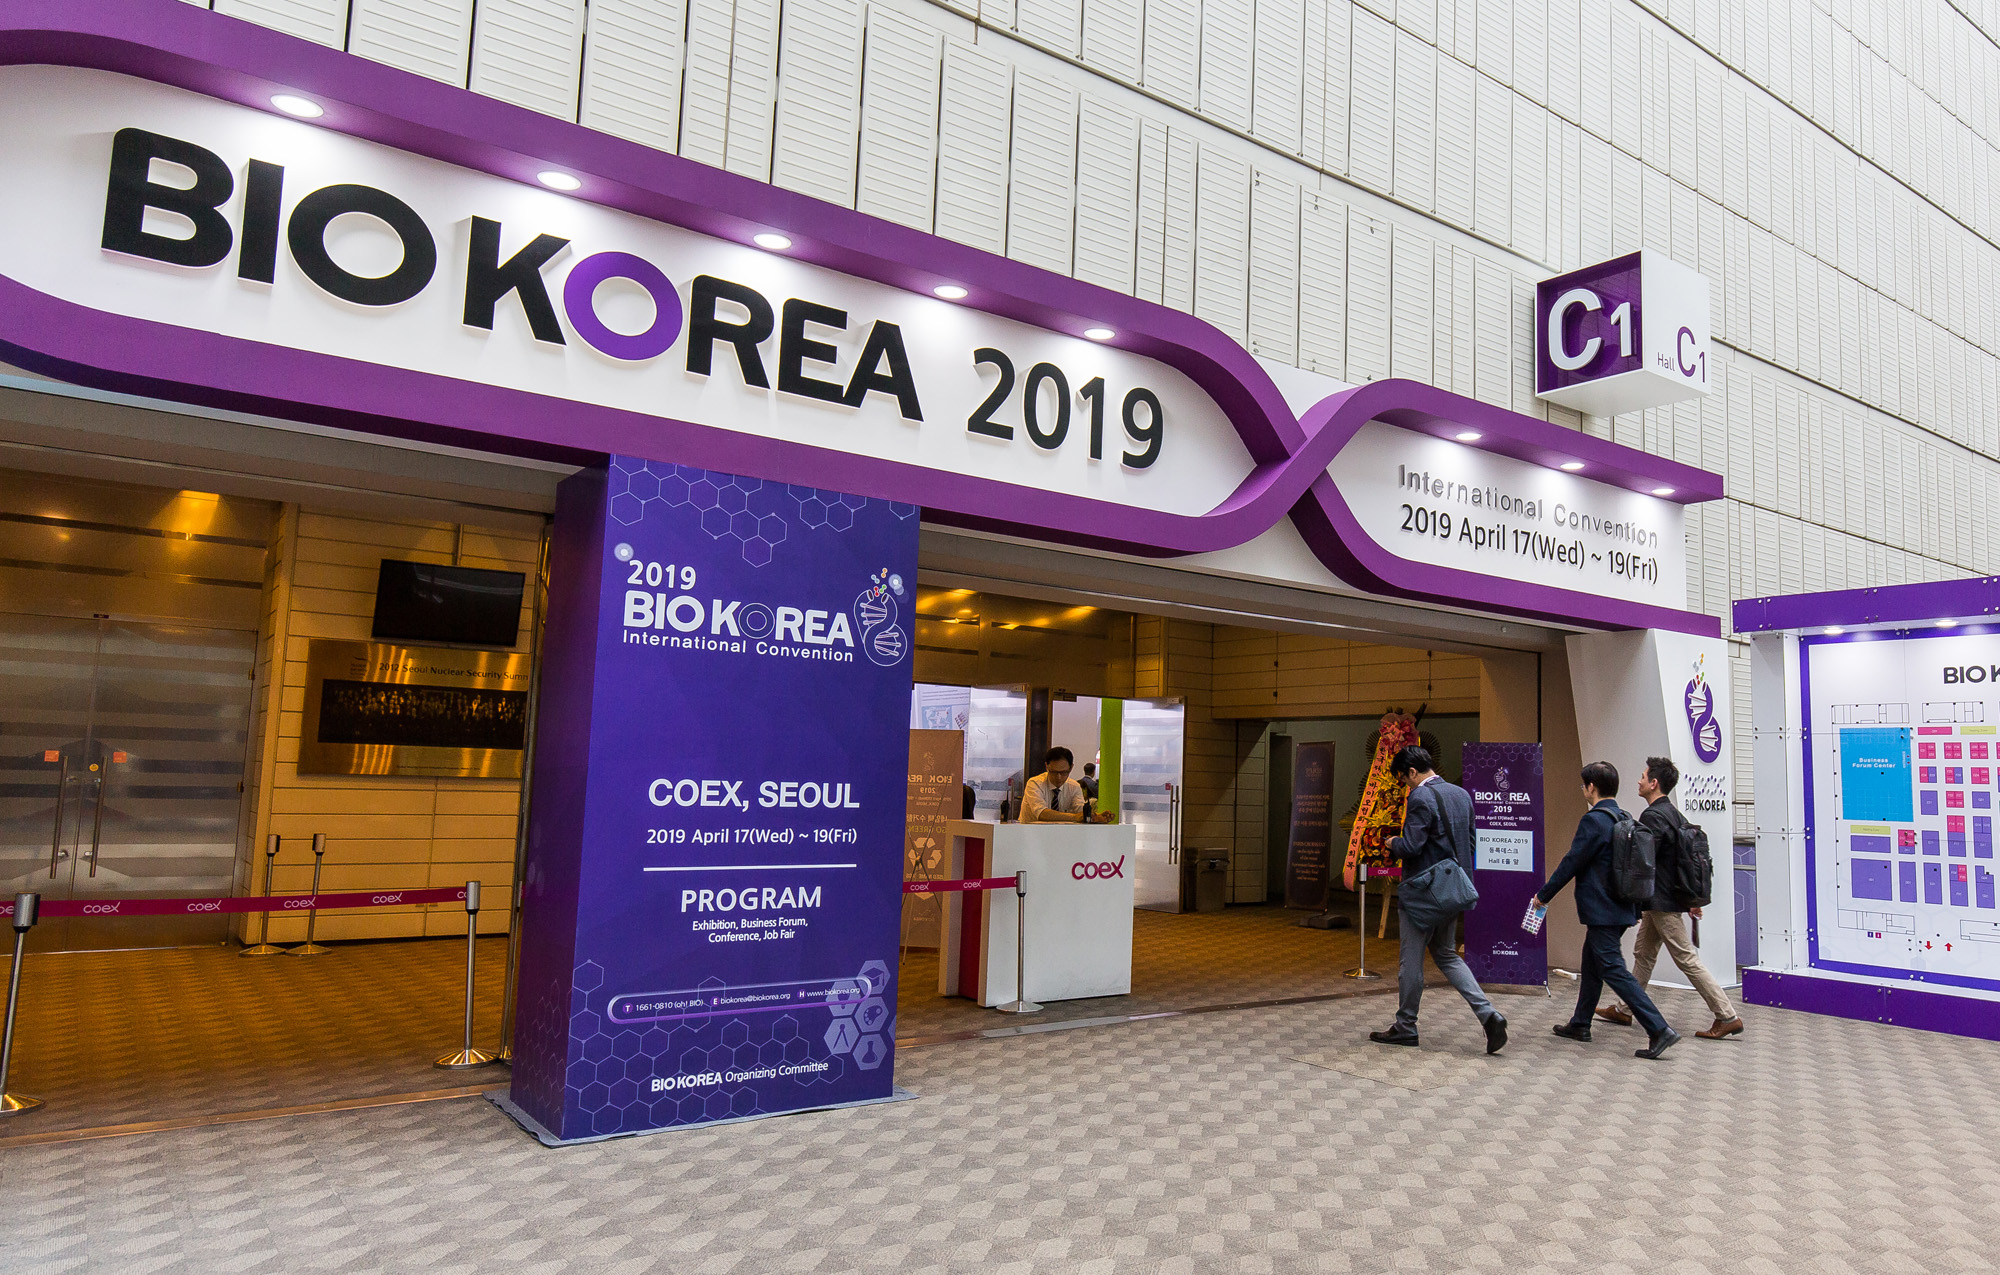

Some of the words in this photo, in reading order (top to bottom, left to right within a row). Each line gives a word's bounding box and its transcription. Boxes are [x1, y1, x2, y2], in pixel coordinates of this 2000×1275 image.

[101, 126, 438, 307] BIO
[462, 214, 925, 423] KOREA
[967, 346, 1165, 470] 2019
[1548, 288, 1632, 371] C1
[1657, 352, 1676, 372] Hall
[1677, 326, 1706, 384] C1
[1398, 464, 1543, 522] International
[1554, 503, 1658, 549] Convention
[1401, 503, 1451, 539] 2019
[1458, 517, 1506, 550] April
[1512, 528, 1585, 569] 17(Wed)
[1591, 552, 1602, 562] ~
[1608, 550, 1658, 584] 19(Fri)
[627, 559, 697, 590] 2019
[623, 589, 705, 633] BIO
[710, 599, 855, 647] KOREA
[623, 629, 747, 653] International
[756, 641, 854, 662] Convention
[379, 662, 399, 672] 2012
[402, 664, 428, 674] Seoul
[430, 667, 465, 677] Nuclear
[466, 669, 501, 680] Security
[1943, 665, 1987, 685] BIO
[649, 778, 750, 812] COEX,
[758, 780, 860, 808] SEOUL
[1475, 791, 1493, 801] BIO
[1494, 791, 1531, 802] KOREA
[1493, 805, 1513, 813] 2019
[646, 829, 686, 844] 2019
[691, 828, 729, 846] April
[734, 828, 794, 845] 17(Wed)
[813, 828, 858, 845] 19(Fri)
[1071, 854, 1125, 880] coex
[910, 882, 930, 891] coex
[963, 879, 982, 889] coex
[83, 901, 120, 914] coex
[187, 899, 222, 912] coex
[284, 896, 316, 909] coex
[372, 891, 403, 905] coex
[681, 886, 822, 912] PROGRAM
[692, 919, 739, 931] Exhibition,
[740, 917, 777, 928] Business
[778, 917, 808, 927] Forum,
[708, 931, 762, 943] Conference,
[763, 930, 778, 941] Job
[780, 929, 796, 939] Fair
[635, 1002, 673, 1011] 1661-0810
[674, 1000, 689, 1009] (oh!
[689, 999, 704, 1008] BIO)
[720, 992, 791, 1005] biokorea@biokorea.org
[807, 986, 861, 998] www.biokorea.org
[651, 1078, 676, 1092] BIO
[677, 1072, 723, 1089] KOREA
[725, 1067, 777, 1083] Organizing
[778, 1062, 829, 1075] Committee
